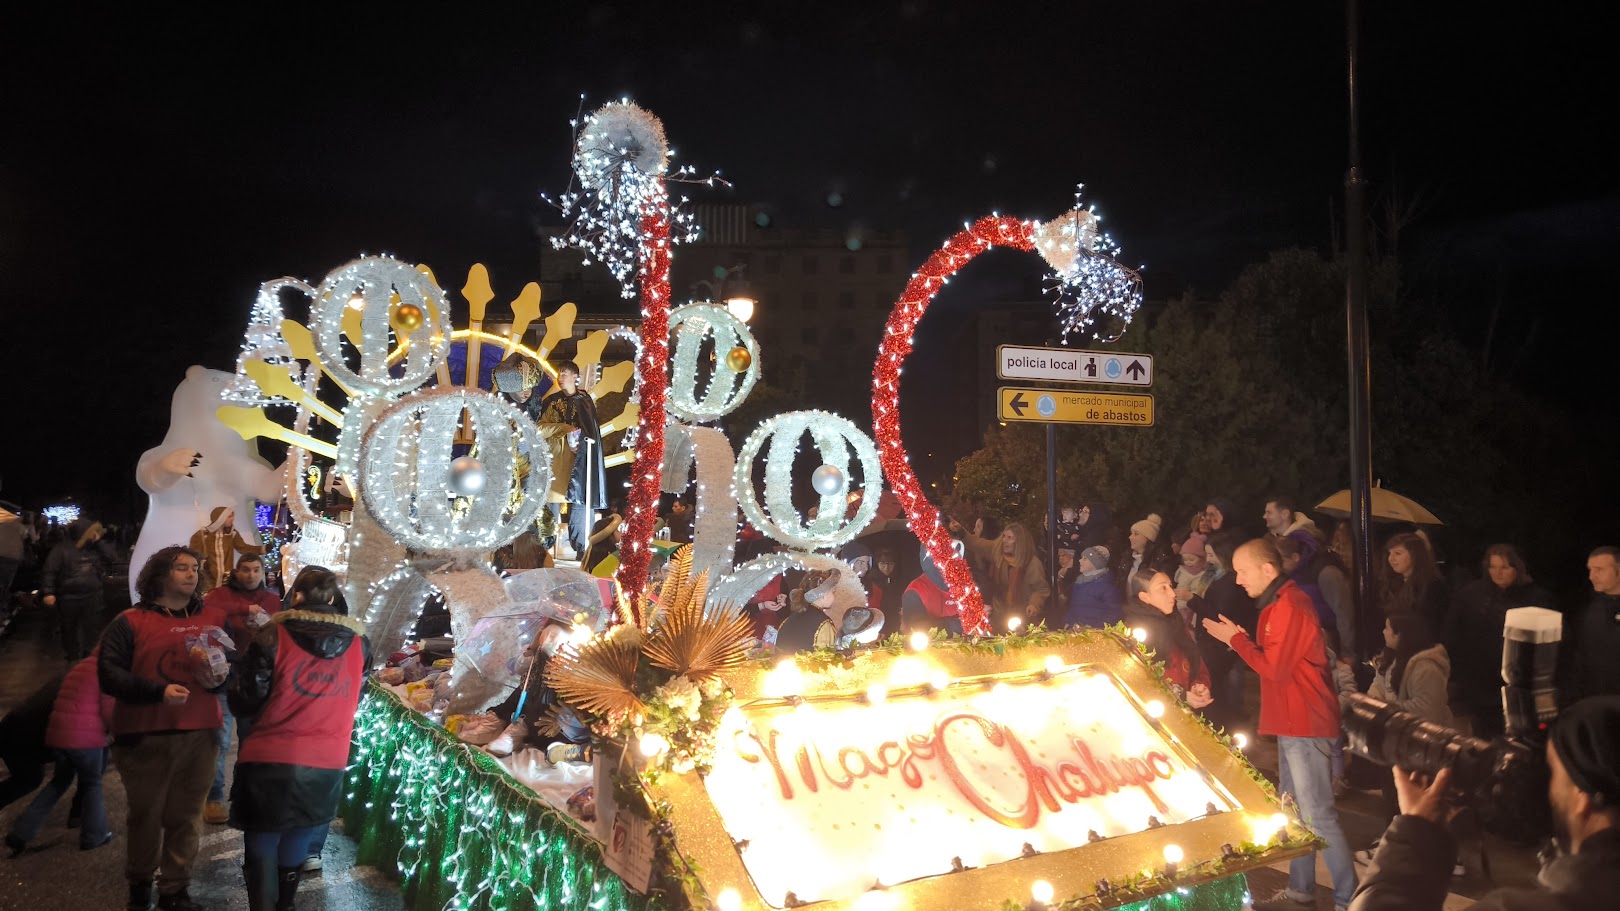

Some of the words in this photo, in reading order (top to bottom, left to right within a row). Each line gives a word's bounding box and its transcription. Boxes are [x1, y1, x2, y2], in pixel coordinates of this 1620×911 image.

[1007, 357, 1046, 369] policía
[1050, 358, 1077, 371] local
[1062, 396, 1102, 406] mercado
[1104, 397, 1147, 408] municipal
[1086, 409, 1100, 420] de
[1103, 410, 1147, 422] abastos
[733, 728, 936, 800] Mago
